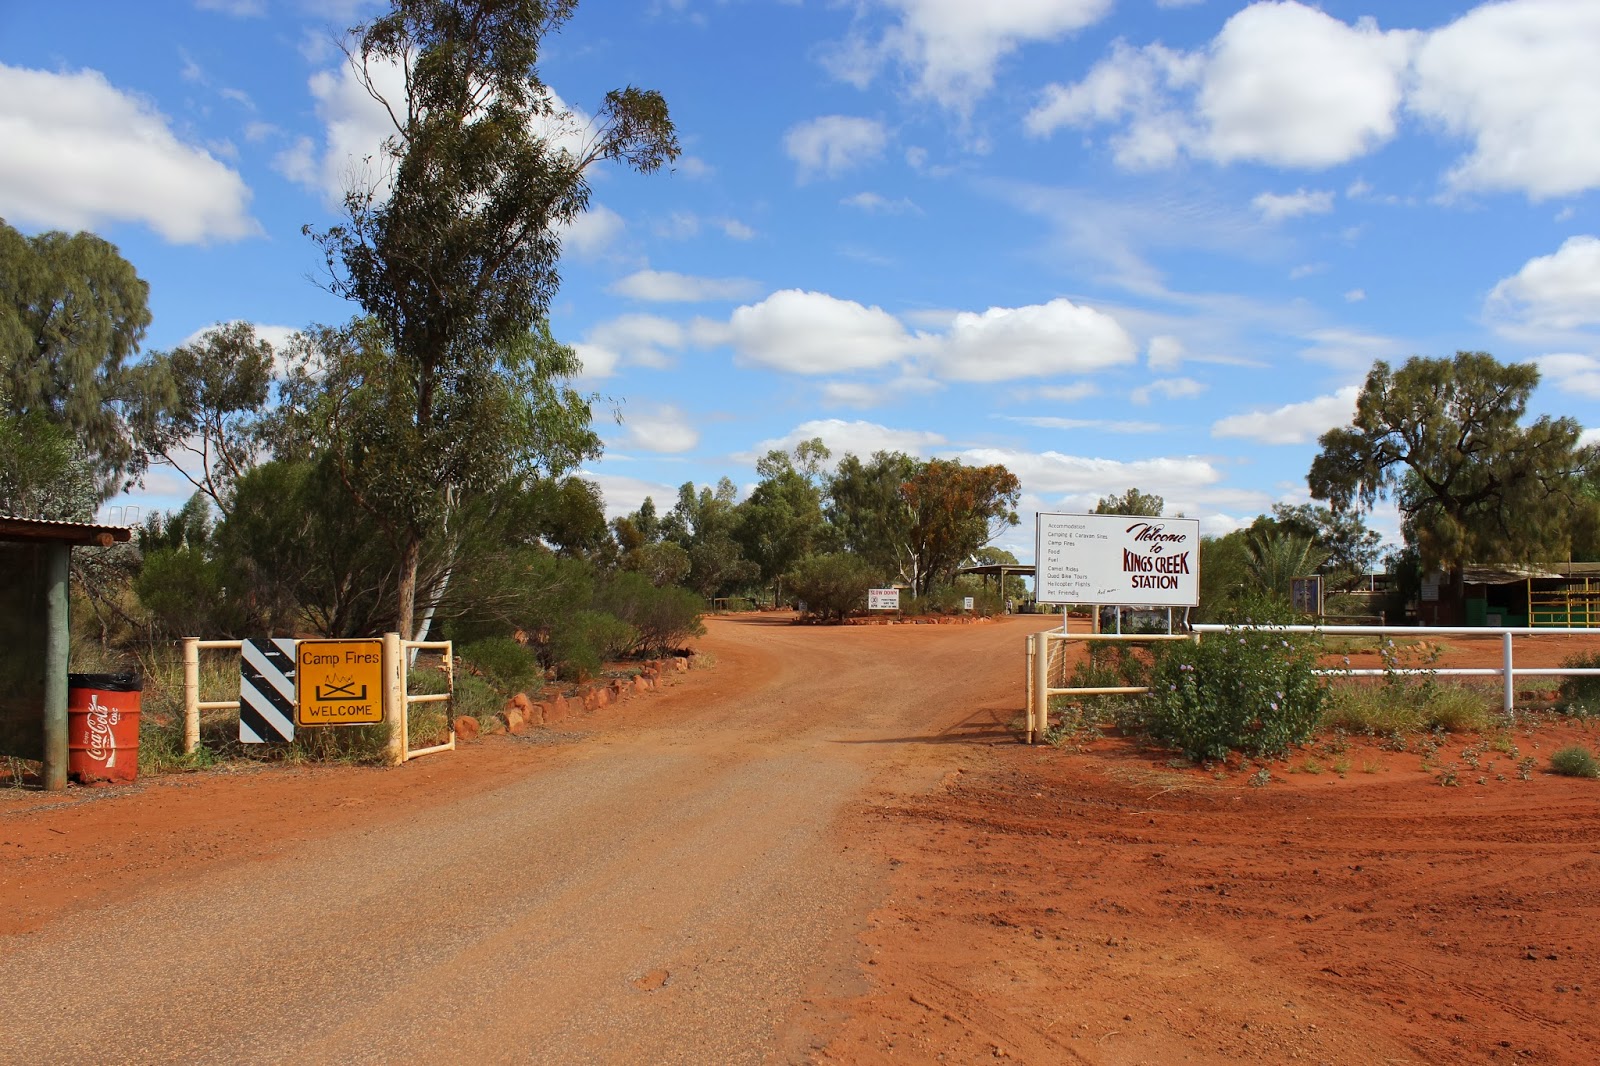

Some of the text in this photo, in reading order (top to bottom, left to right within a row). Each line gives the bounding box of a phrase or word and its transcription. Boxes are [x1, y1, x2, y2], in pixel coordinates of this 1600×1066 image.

[1126, 523, 1187, 543] Welcome
[1149, 542, 1164, 554] to
[1123, 547, 1190, 575] KINGS CREEK
[1131, 574, 1178, 590] STATION
[1058, 589, 1079, 597] Friendly
[302, 651, 380, 668] Camp Fires
[108, 707, 119, 726] Coke
[308, 705, 373, 717] WELCOME
